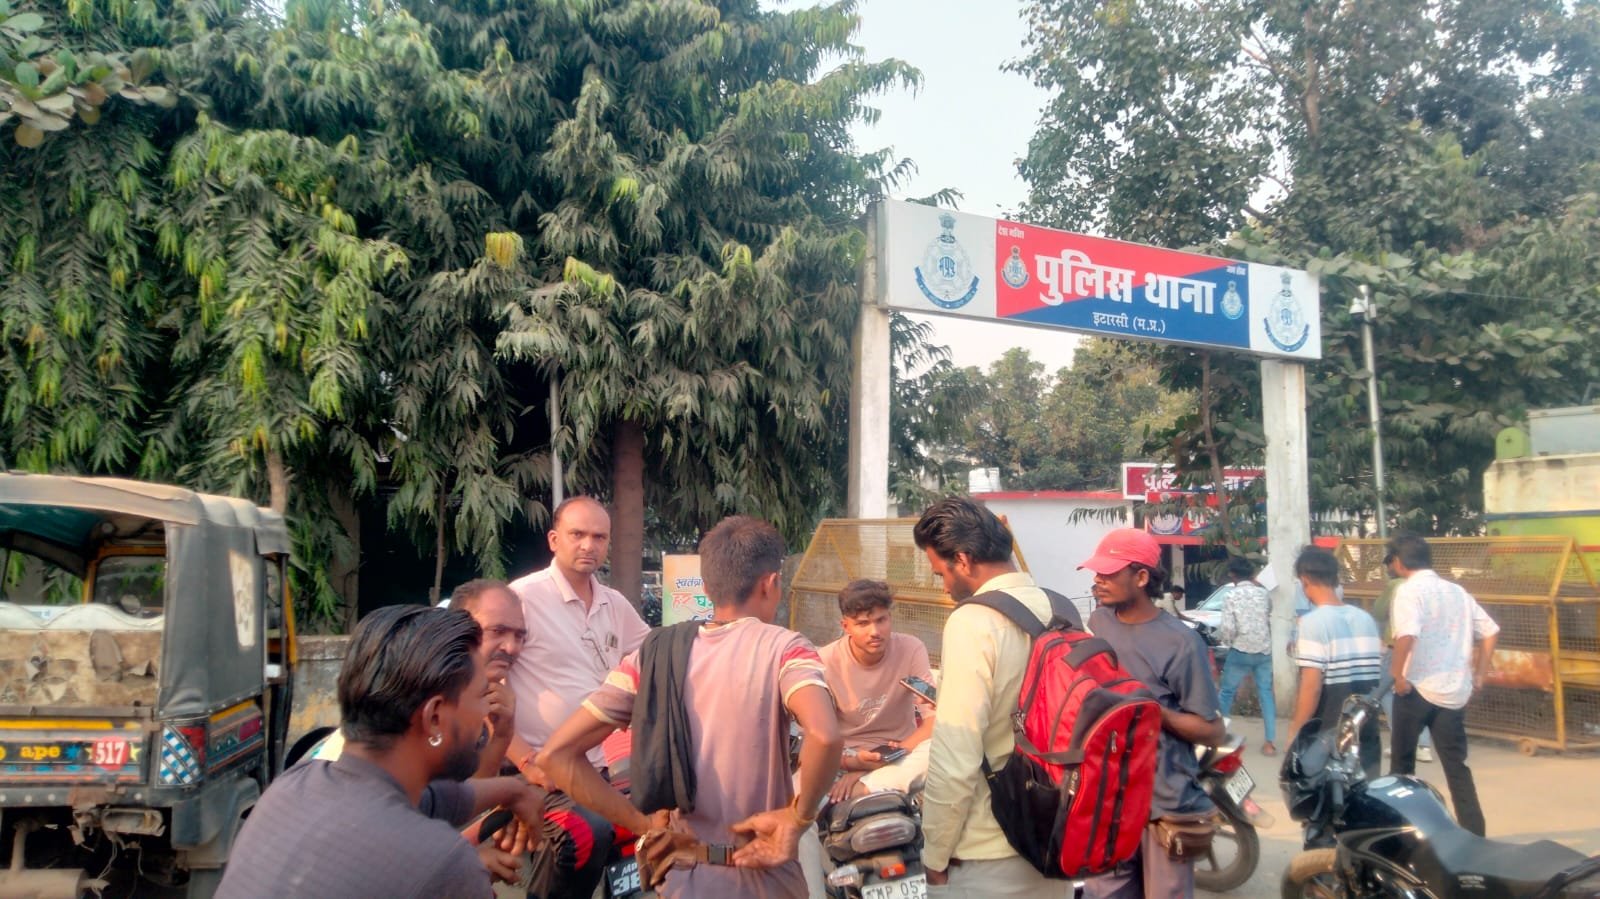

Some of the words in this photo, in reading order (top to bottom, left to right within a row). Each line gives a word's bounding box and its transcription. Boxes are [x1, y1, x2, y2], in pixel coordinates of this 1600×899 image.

[1034, 248, 1136, 306] पुलिस
[1144, 272, 1217, 314] थाना
[1092, 311, 1129, 329] इटारसी
[1133, 316, 1166, 334] (म.प्र.)
[693, 595, 714, 607] घ
[20, 746, 61, 760] ape
[95, 741, 125, 764] 517
[876, 885, 893, 899] MP
[900, 880, 919, 896] 05
